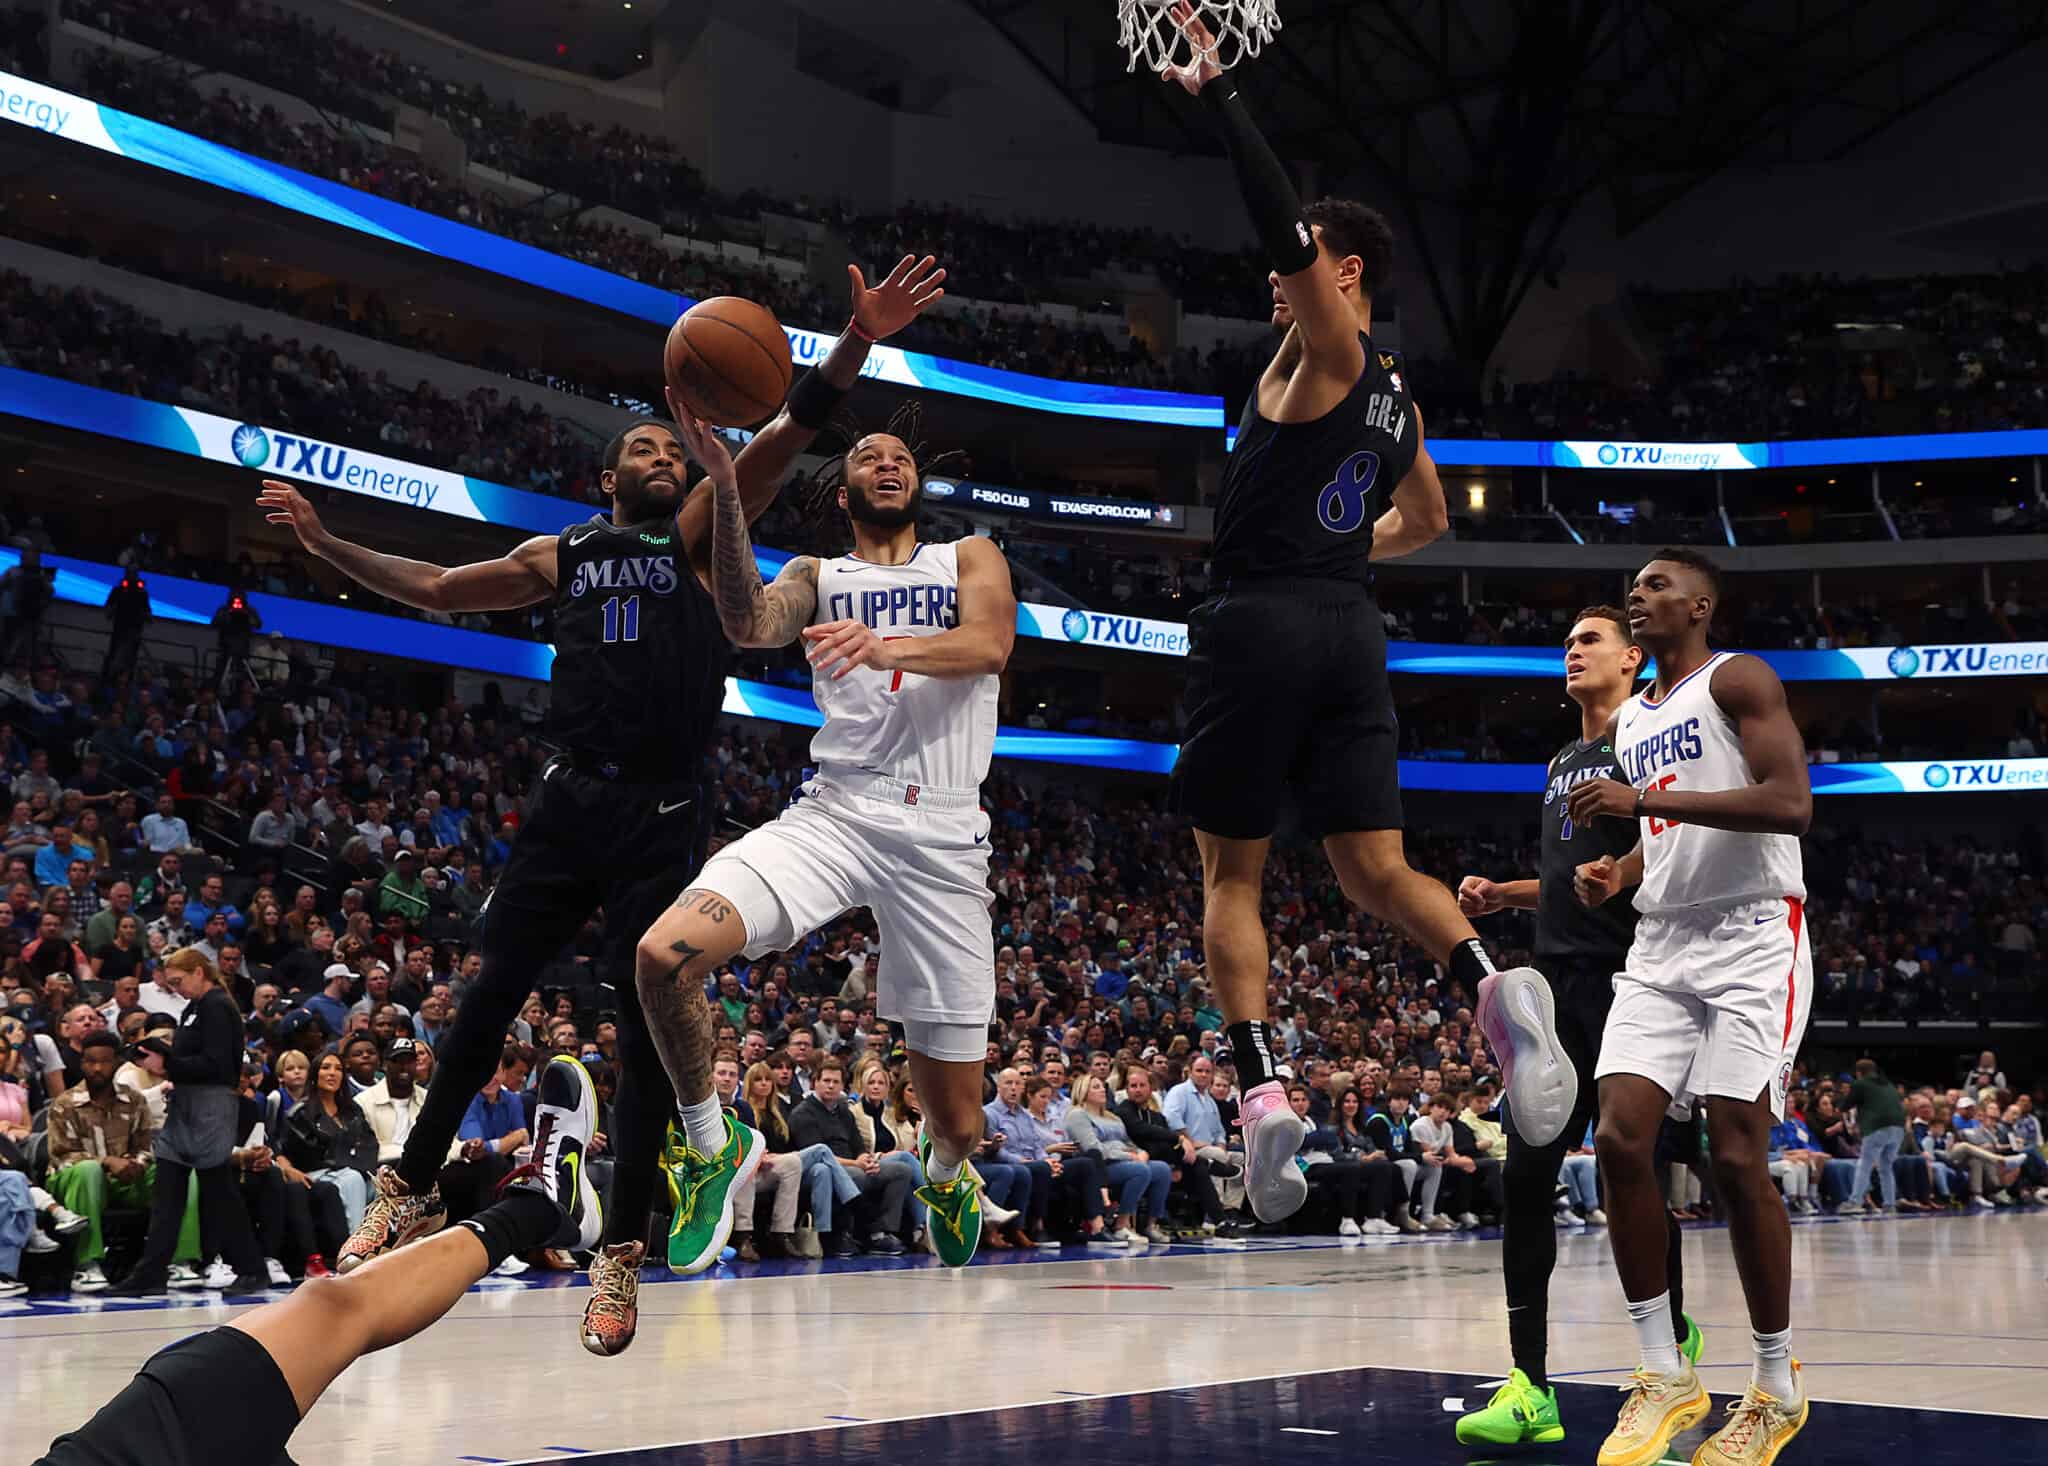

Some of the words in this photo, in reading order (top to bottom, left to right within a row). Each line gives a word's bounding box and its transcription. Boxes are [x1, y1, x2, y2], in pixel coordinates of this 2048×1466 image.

[1050, 500, 1151, 520] TEXASFORD.COM
[1317, 450, 1381, 534] 8
[571, 556, 678, 597] MAVS
[601, 595, 640, 643] 11
[1622, 717, 1703, 784] CLIPPERS
[699, 897, 732, 923] US
